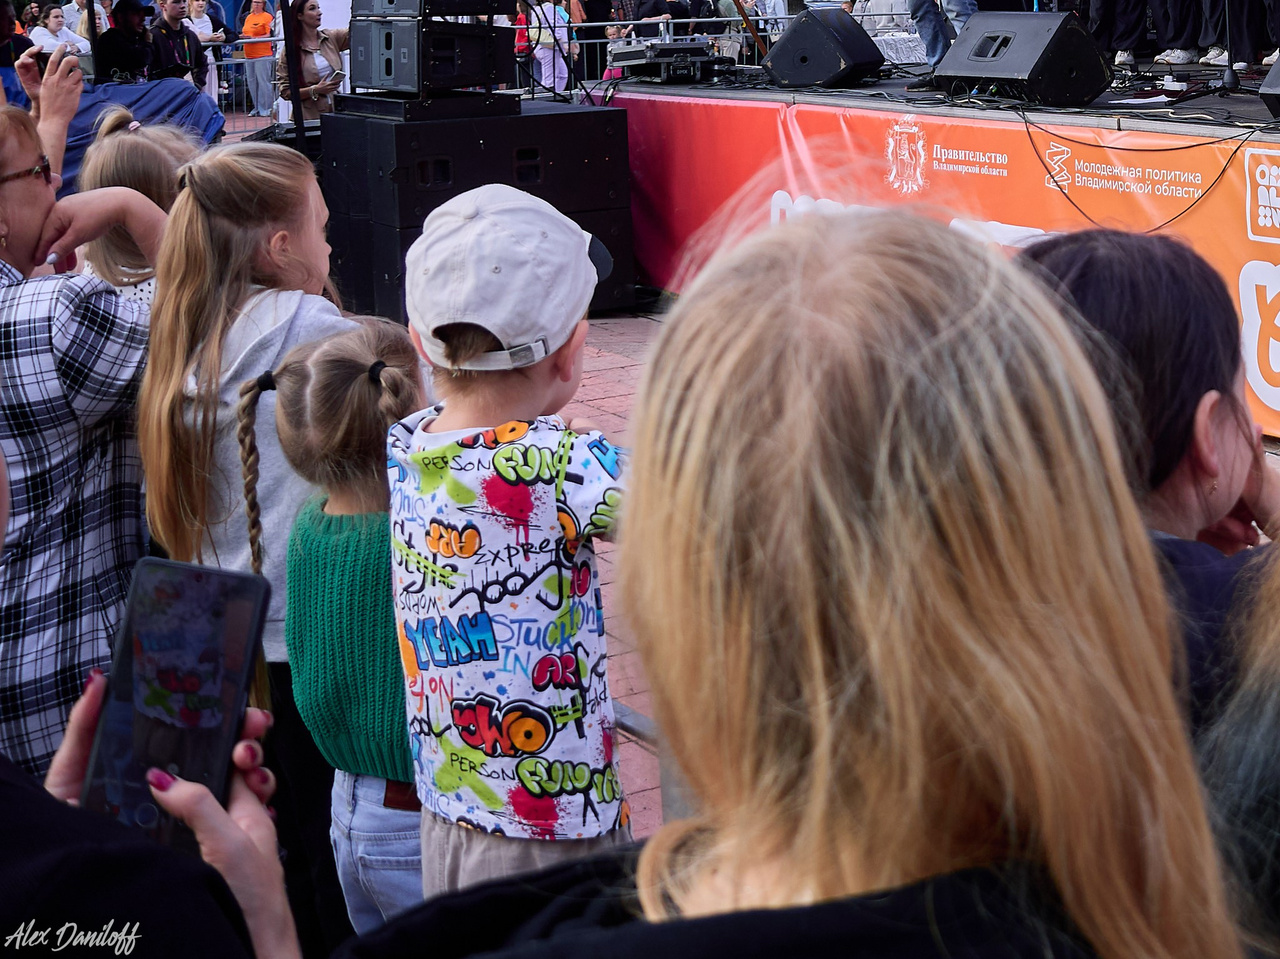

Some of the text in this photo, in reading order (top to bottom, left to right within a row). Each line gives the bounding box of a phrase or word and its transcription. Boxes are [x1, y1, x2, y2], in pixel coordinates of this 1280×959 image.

[932, 144, 1008, 165] Правительство
[933, 160, 1008, 177] Владимирской области
[1074, 159, 1202, 184] Молодежная политика
[1075, 173, 1202, 198] Владимирской области
[421, 455, 491, 472] PERSON
[404, 611, 500, 671] YEAH
[493, 613, 576, 655] STUCK
[497, 644, 532, 681] IN
[449, 752, 516, 781] PERSON
[516, 756, 592, 798] FUN
